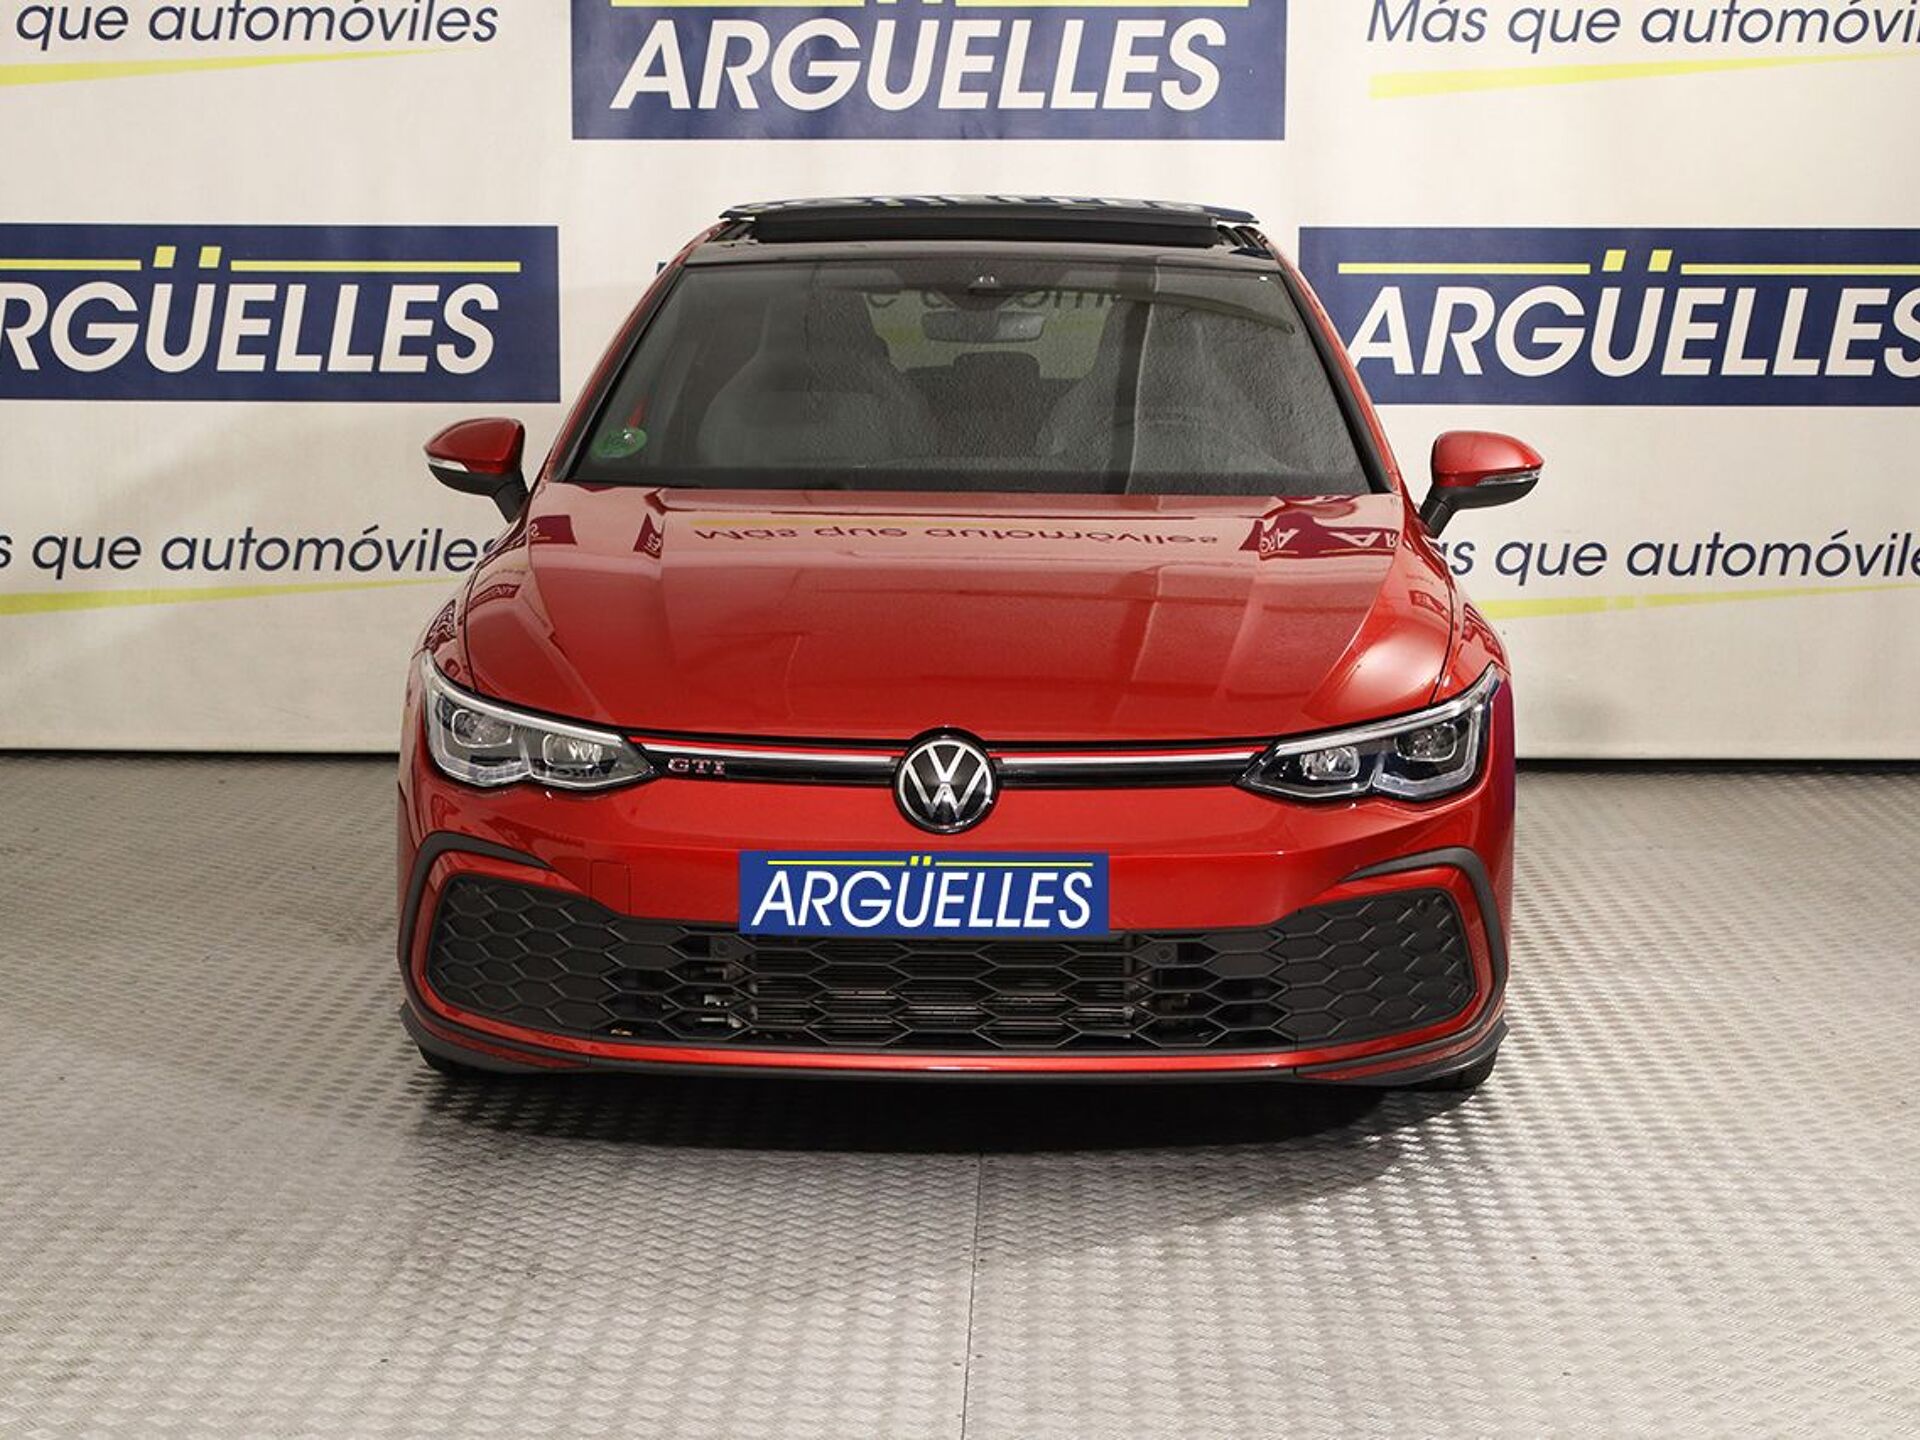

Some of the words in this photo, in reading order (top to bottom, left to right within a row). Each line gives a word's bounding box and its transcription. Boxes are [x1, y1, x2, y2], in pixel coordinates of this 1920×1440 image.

[16, 5, 129, 51] que
[148, 0, 498, 42] automóviles
[1508, 8, 1621, 54] que
[1641, 0, 1920, 44] automóvi
[32, 535, 142, 580] que
[161, 525, 496, 572] automóvile
[1495, 541, 1607, 586] que
[1626, 530, 1920, 577] automóvil
[668, 758, 725, 775] GTI
[751, 855, 1093, 929] ARGÜELLES
